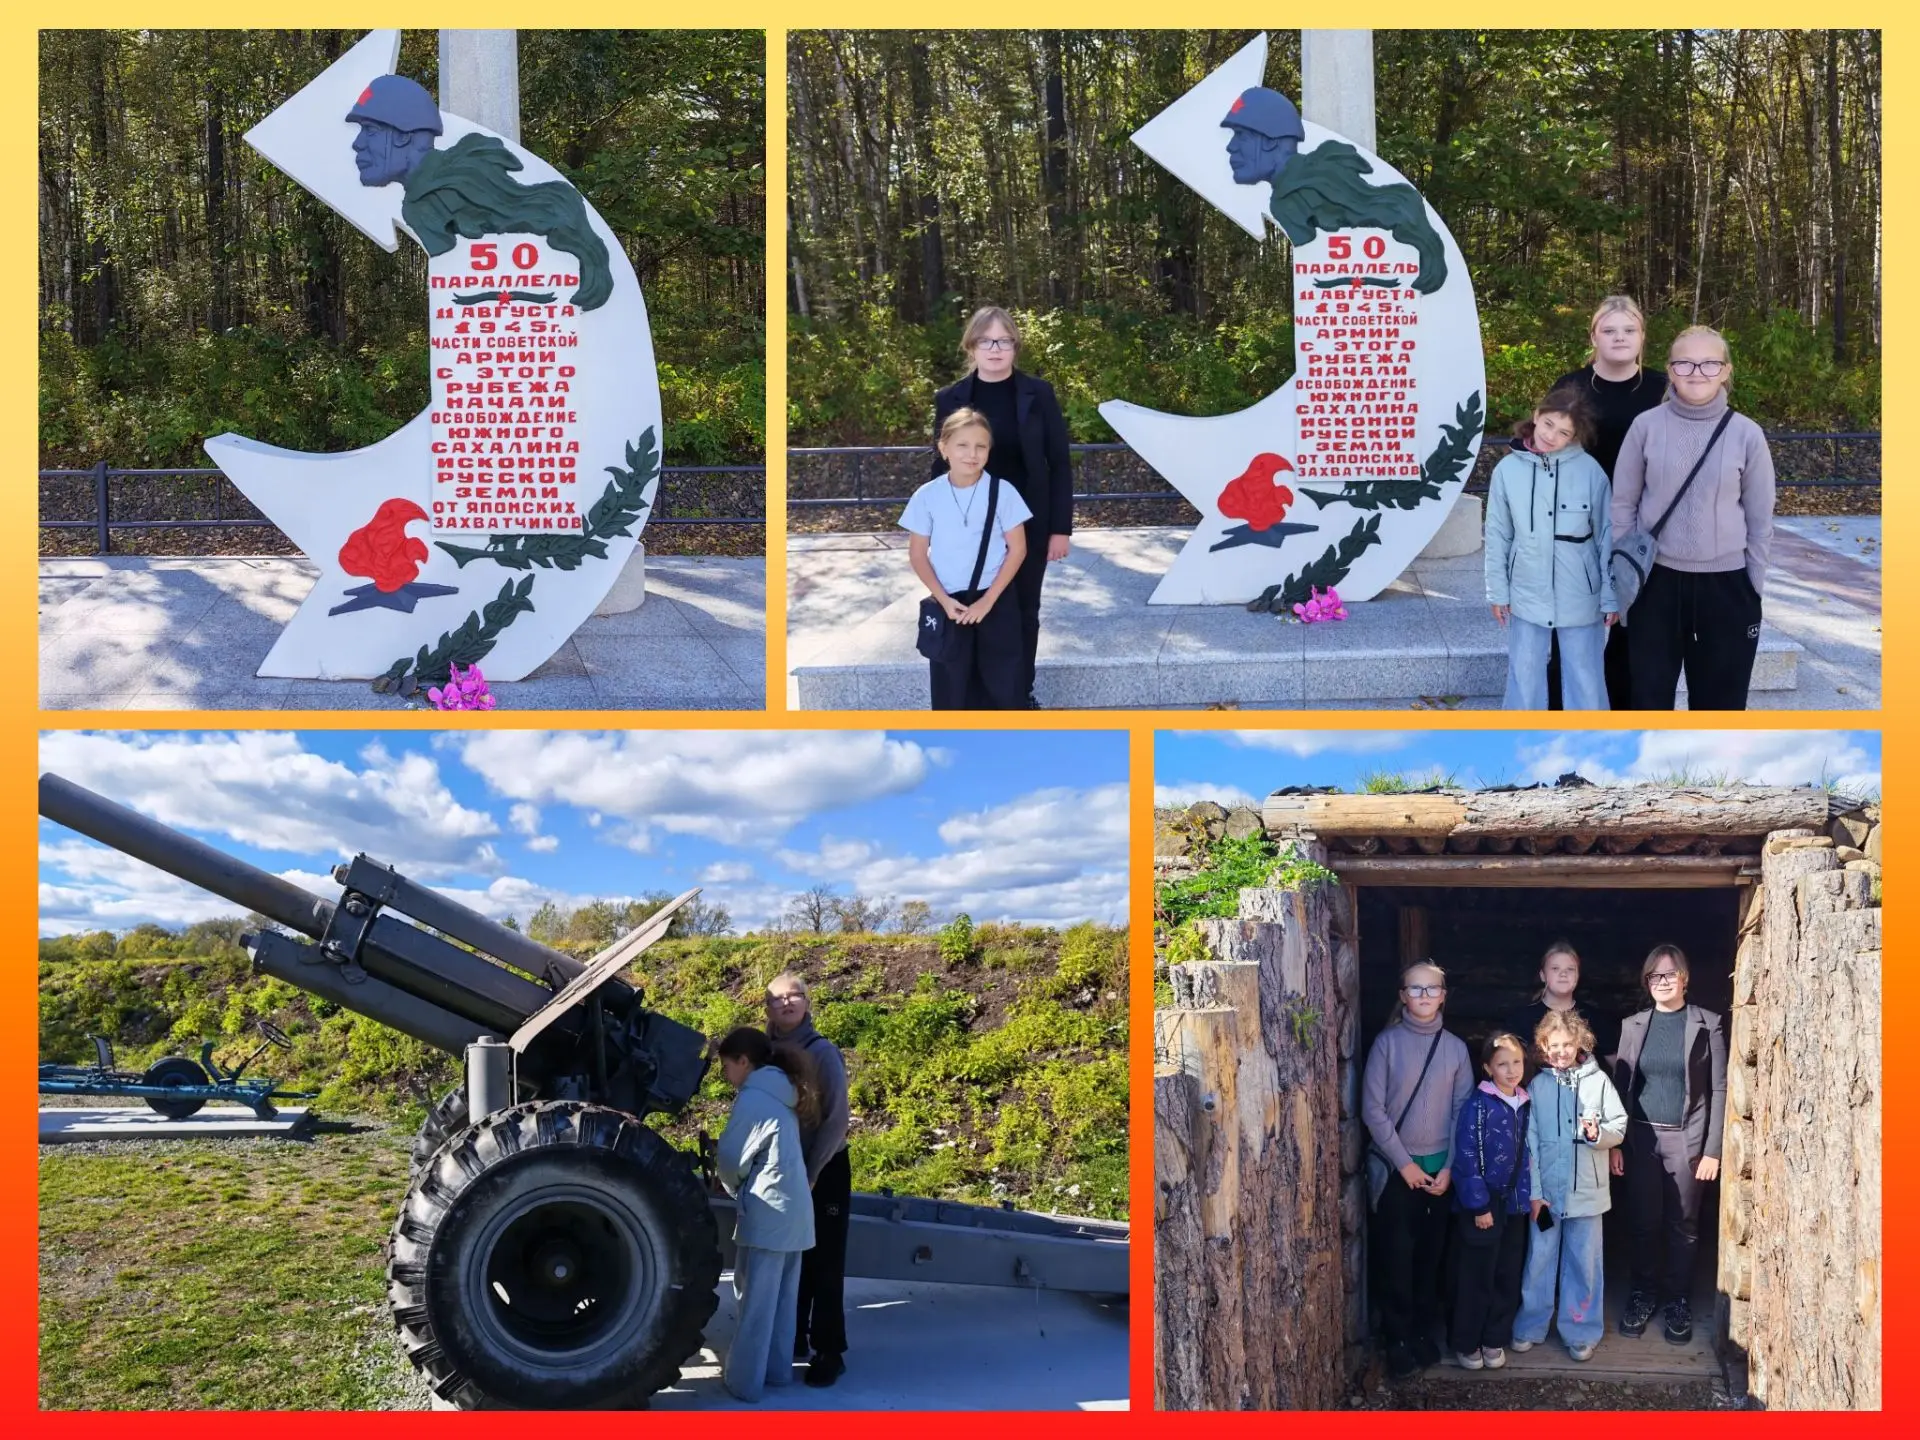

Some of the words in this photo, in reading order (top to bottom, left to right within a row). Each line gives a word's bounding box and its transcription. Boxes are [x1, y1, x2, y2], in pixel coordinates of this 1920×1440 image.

[1328, 235, 1386, 260] 50
[470, 242, 539, 271] 50
[1295, 262, 1418, 274] ПАРАЛЛЕЛЬ
[431, 273, 580, 290] ПАРАЛЛЕЛЬ
[1299, 291, 1315, 301] 11
[1321, 288, 1415, 302] АВГУСТА
[435, 307, 454, 320] 11
[461, 304, 575, 319] АВГУСТА
[1296, 314, 1338, 326] ЧАСТИ
[1342, 311, 1418, 326] СОВЕТСКОЙ
[431, 335, 482, 349] ЧАСТИ
[487, 329, 578, 348] СОВЕТСКОЙ
[1316, 327, 1400, 340] АРМИИ
[1300, 342, 1315, 352] С
[1334, 340, 1416, 352] ЭТОГО
[456, 351, 557, 364] АРМИИ
[1308, 353, 1411, 365] РУБЕЖА
[436, 367, 454, 379] С
[477, 365, 576, 379] ЭТОГО
[1308, 365, 1407, 378] НАЧАЛИ
[446, 380, 570, 395] РУБЕЖА
[1296, 378, 1417, 390] ОСВОБОЖДЕНИЕ
[446, 396, 566, 409] НАЧАЛИ
[1309, 391, 1406, 403] ЮЖНОГО
[1296, 403, 1419, 415] САХАЛИНА
[431, 410, 577, 425] ОСВОБОЖДЕНИЕ
[1301, 415, 1416, 428] ИСКОННО
[448, 426, 564, 440] ЮЖНОГО
[431, 441, 580, 455] САХАЛИНА
[1316, 440, 1401, 453] ЗЕМЛИ
[437, 456, 576, 469] ИСКОННО
[1297, 454, 1318, 465] ОТ
[1324, 453, 1415, 464] ЯПОНСКИХ
[1298, 465, 1420, 477] ЗАХВАТЧИКОВ
[455, 486, 559, 500] ЗЕМЛИ
[432, 501, 459, 515] ОТ
[466, 501, 576, 515] ЯПОНСКИХ
[433, 516, 582, 529] ЗАХВАТЧИКОВ
